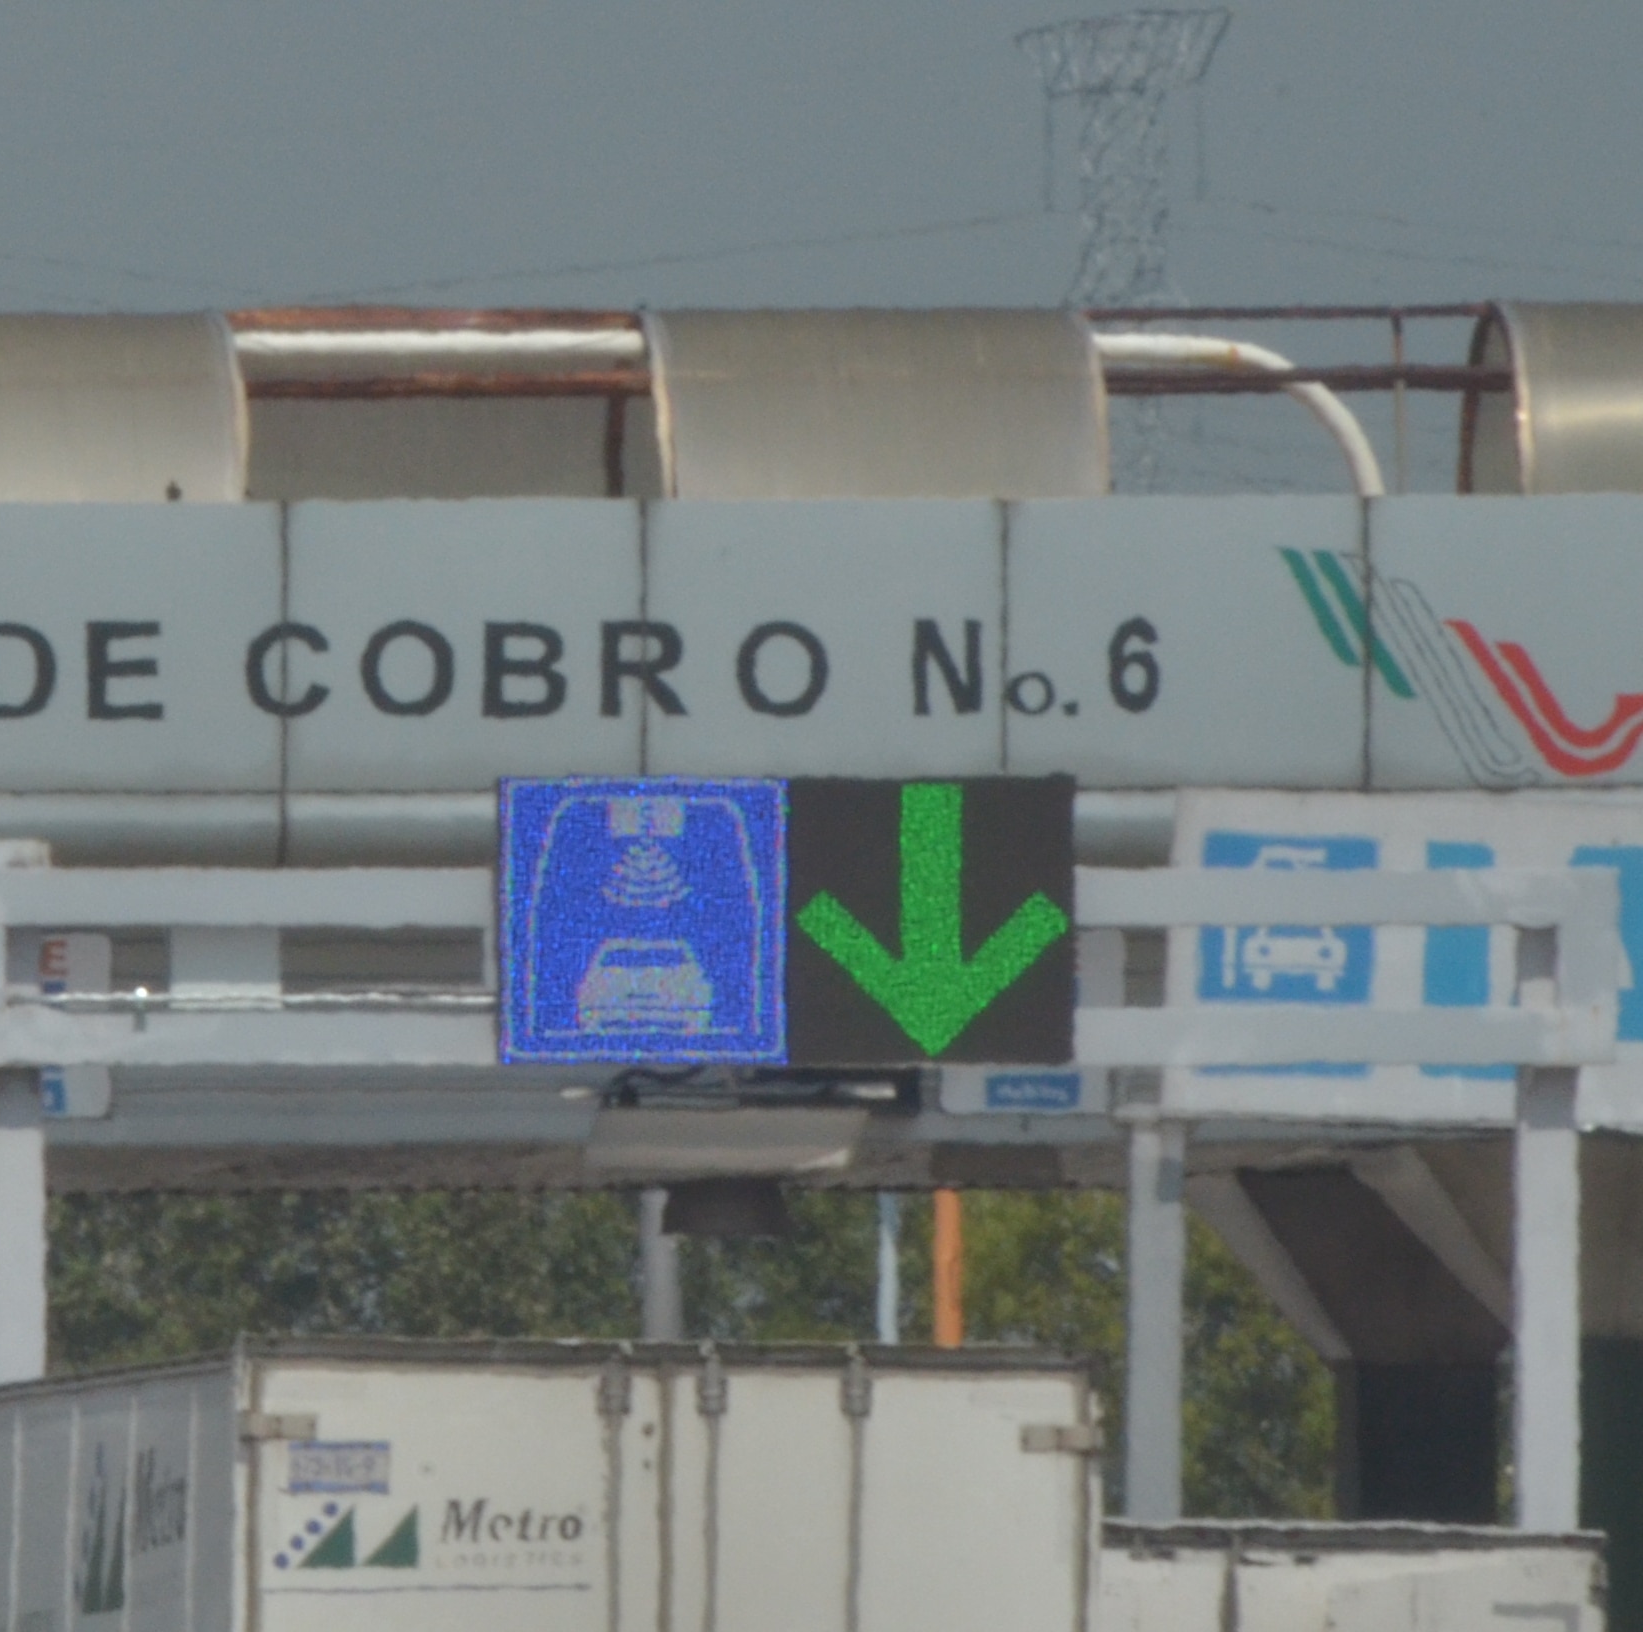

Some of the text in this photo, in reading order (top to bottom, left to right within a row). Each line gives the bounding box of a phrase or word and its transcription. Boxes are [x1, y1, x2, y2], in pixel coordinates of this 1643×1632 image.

[244, 618, 832, 718] COBRO
[912, 617, 1078, 715] No.
[1107, 616, 1162, 714] 6
[439, 1496, 583, 1545] Metro
